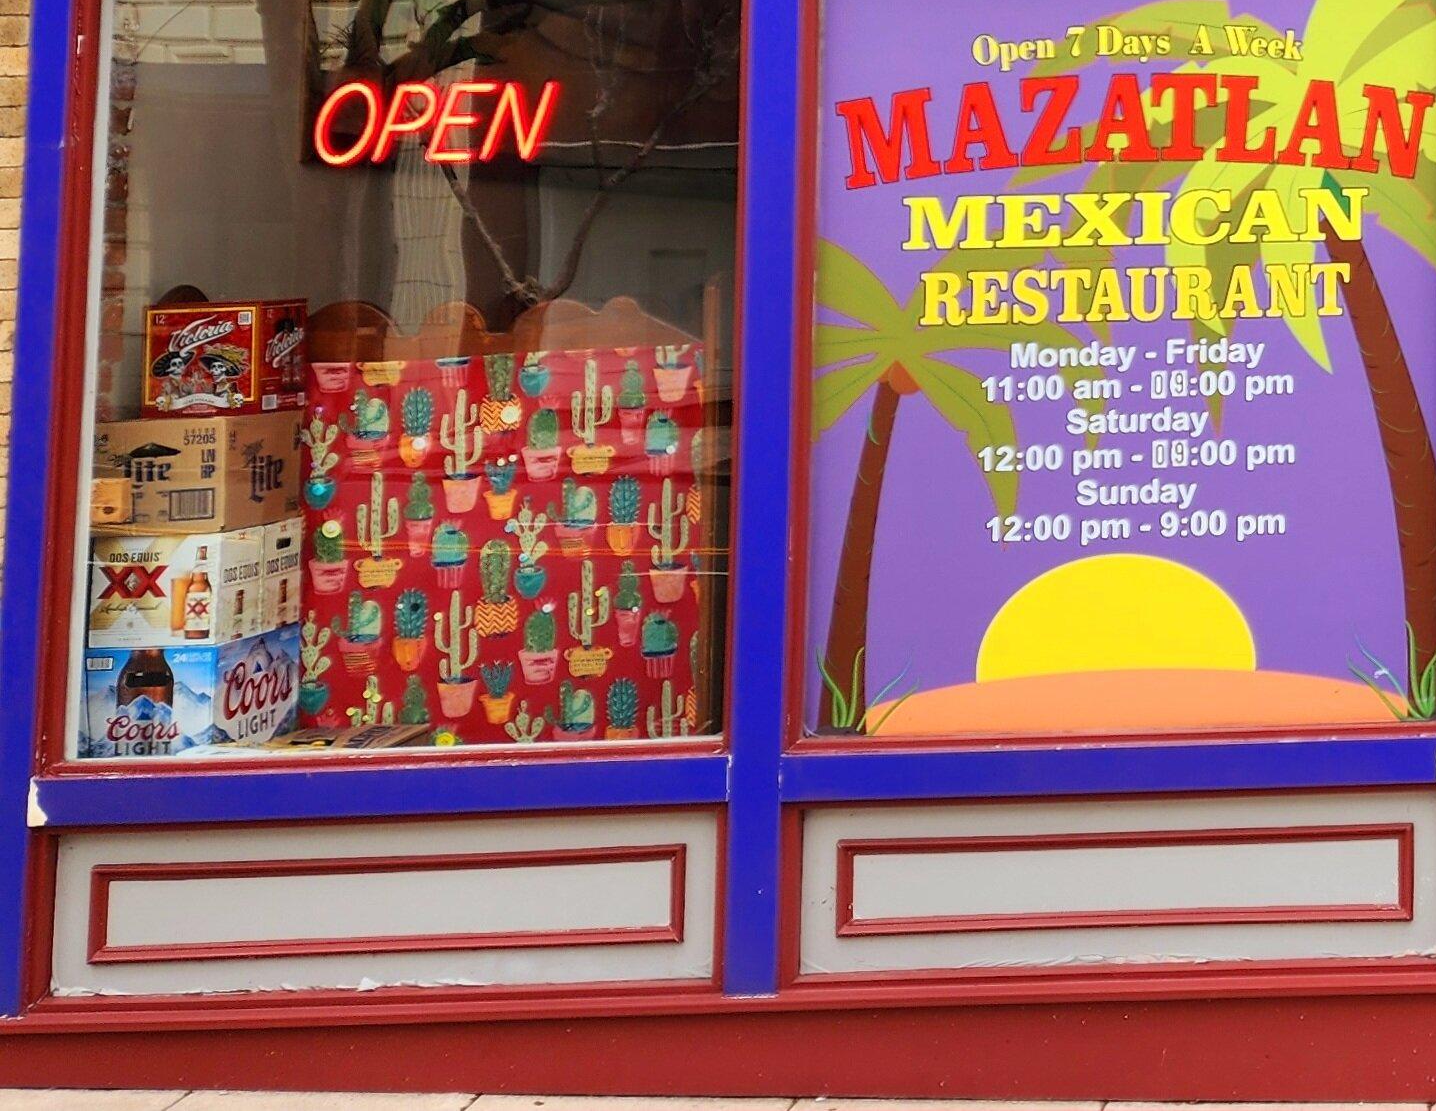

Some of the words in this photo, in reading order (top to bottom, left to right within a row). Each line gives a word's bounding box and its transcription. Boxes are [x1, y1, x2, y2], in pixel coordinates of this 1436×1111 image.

[971, 32, 1056, 72] Open
[1065, 26, 1086, 58] 7
[1096, 25, 1171, 63] Days
[1188, 25, 1215, 56] A
[1223, 25, 1304, 62] Week
[313, 81, 558, 166] OPEN
[835, 73, 1436, 190] MAZATLAN
[901, 187, 1370, 251] MEXICAN
[919, 261, 1352, 328] RESTAURANT
[154, 313, 166, 326] 12
[168, 315, 236, 356] Victoria
[1010, 341, 1137, 373] Monday
[1165, 338, 1266, 369] Friday
[980, 374, 1064, 403] 11:00
[1072, 377, 1122, 401] am
[1245, 371, 1295, 400] pm
[1065, 406, 1210, 438] Saturday
[183, 433, 216, 446] 57205
[977, 444, 1064, 473] 12:00
[1072, 448, 1123, 476] pm
[1246, 441, 1297, 471] pm
[1076, 478, 1198, 510] Sunday
[985, 513, 1071, 544] 12:00
[1080, 516, 1131, 546] pm
[1159, 509, 1227, 539] 9:00
[1236, 511, 1287, 541] pm
[109, 553, 129, 563] DOS
[131, 551, 161, 563] EQUIS
[97, 565, 169, 599] XX
[223, 661, 293, 721] Coors
[105, 715, 180, 741] Coors
[237, 708, 277, 740] LIGHT
[114, 741, 172, 757] LIGHT
